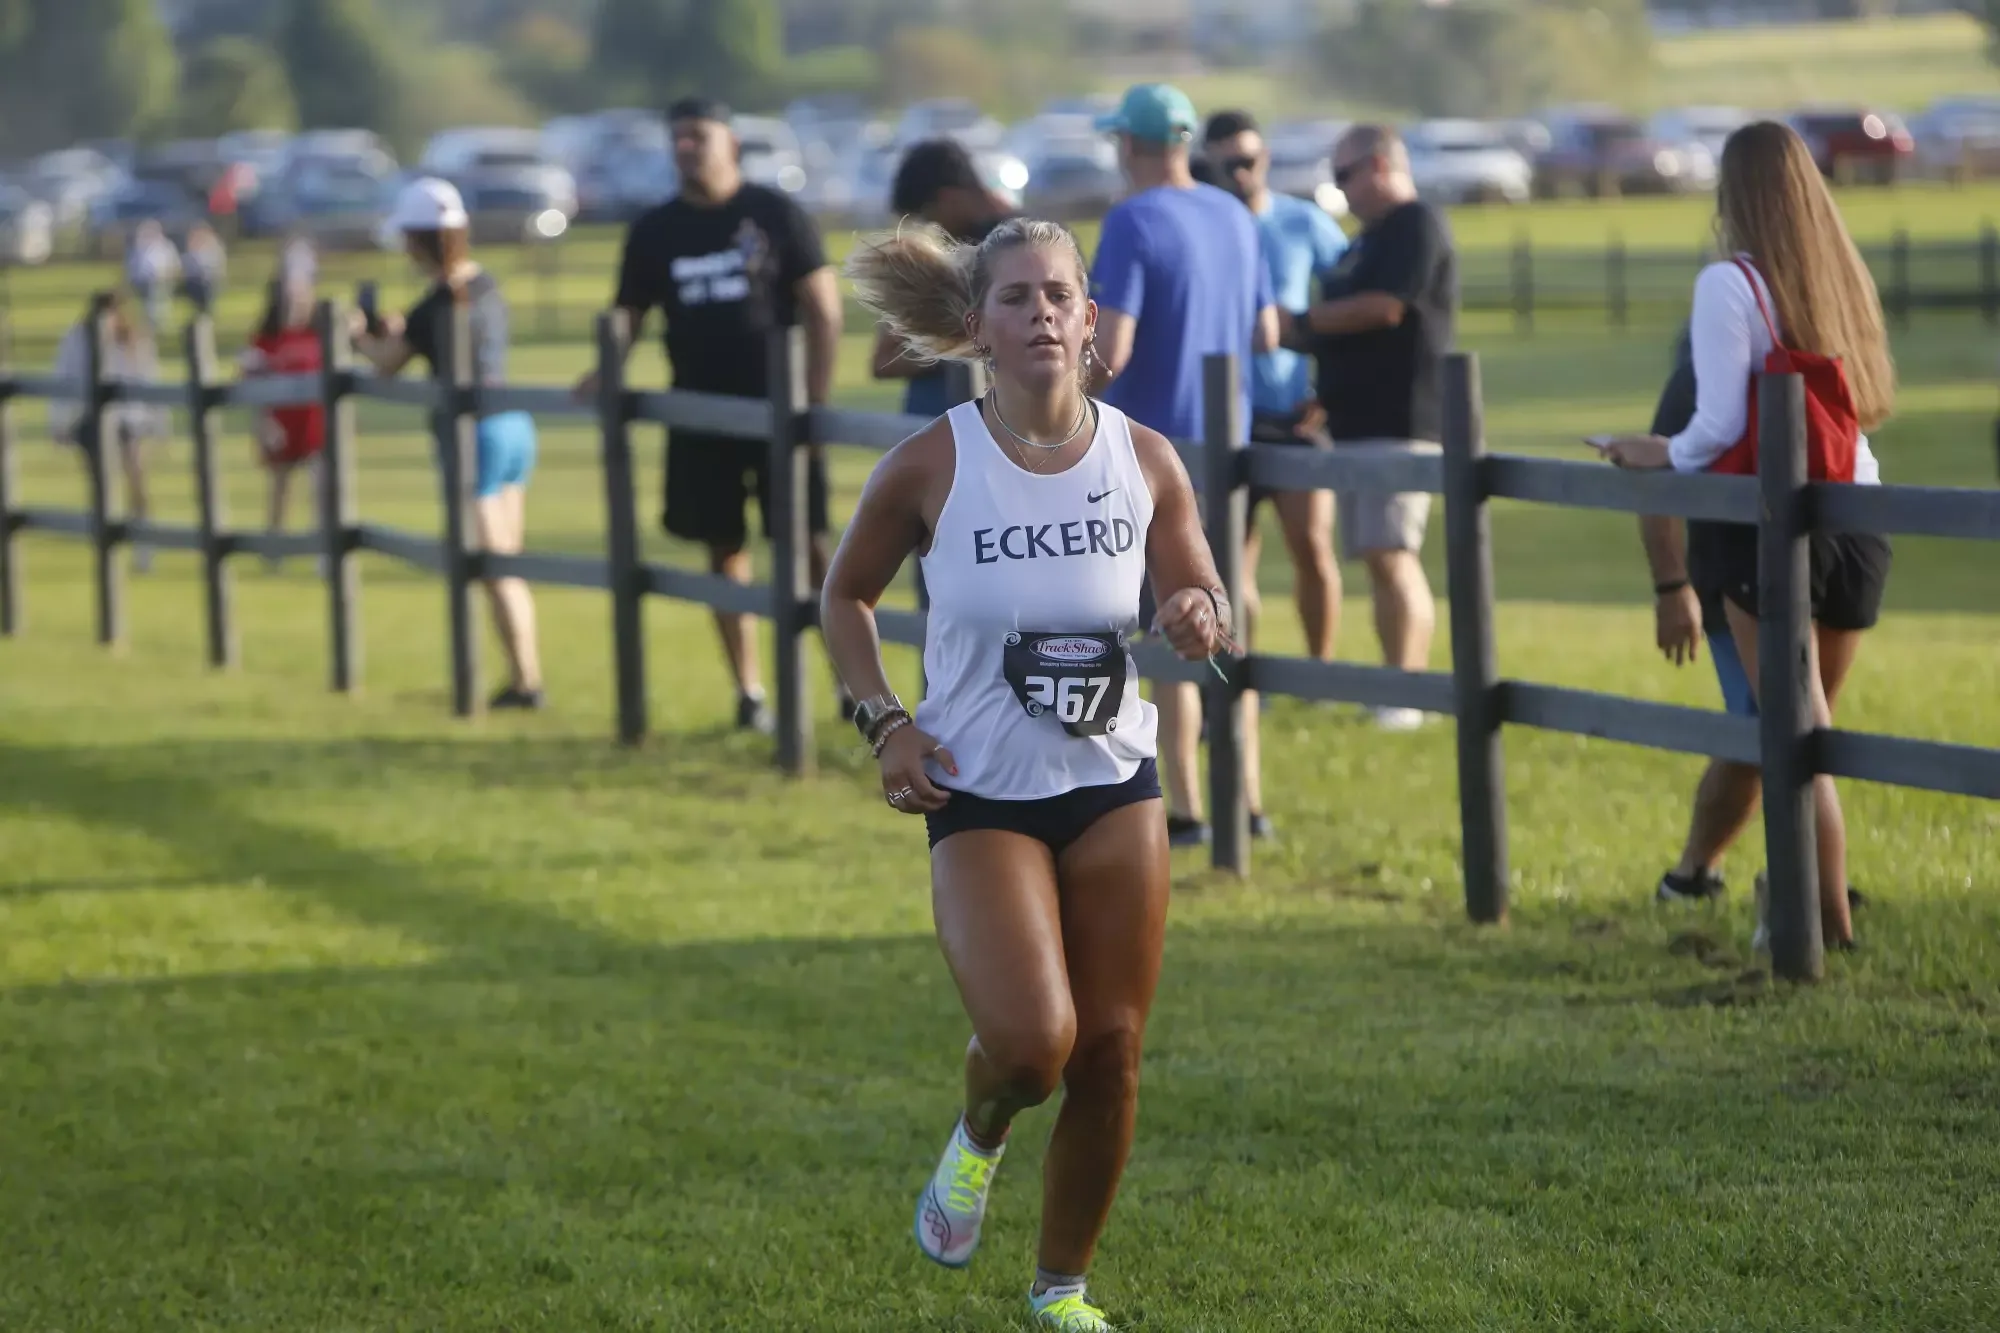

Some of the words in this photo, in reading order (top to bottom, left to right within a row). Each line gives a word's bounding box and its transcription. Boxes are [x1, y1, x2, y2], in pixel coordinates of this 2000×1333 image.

[973, 518, 1134, 564] ECKERD
[1037, 640, 1070, 653] Track
[1072, 643, 1107, 654] Shack
[1025, 676, 1110, 723] 267
